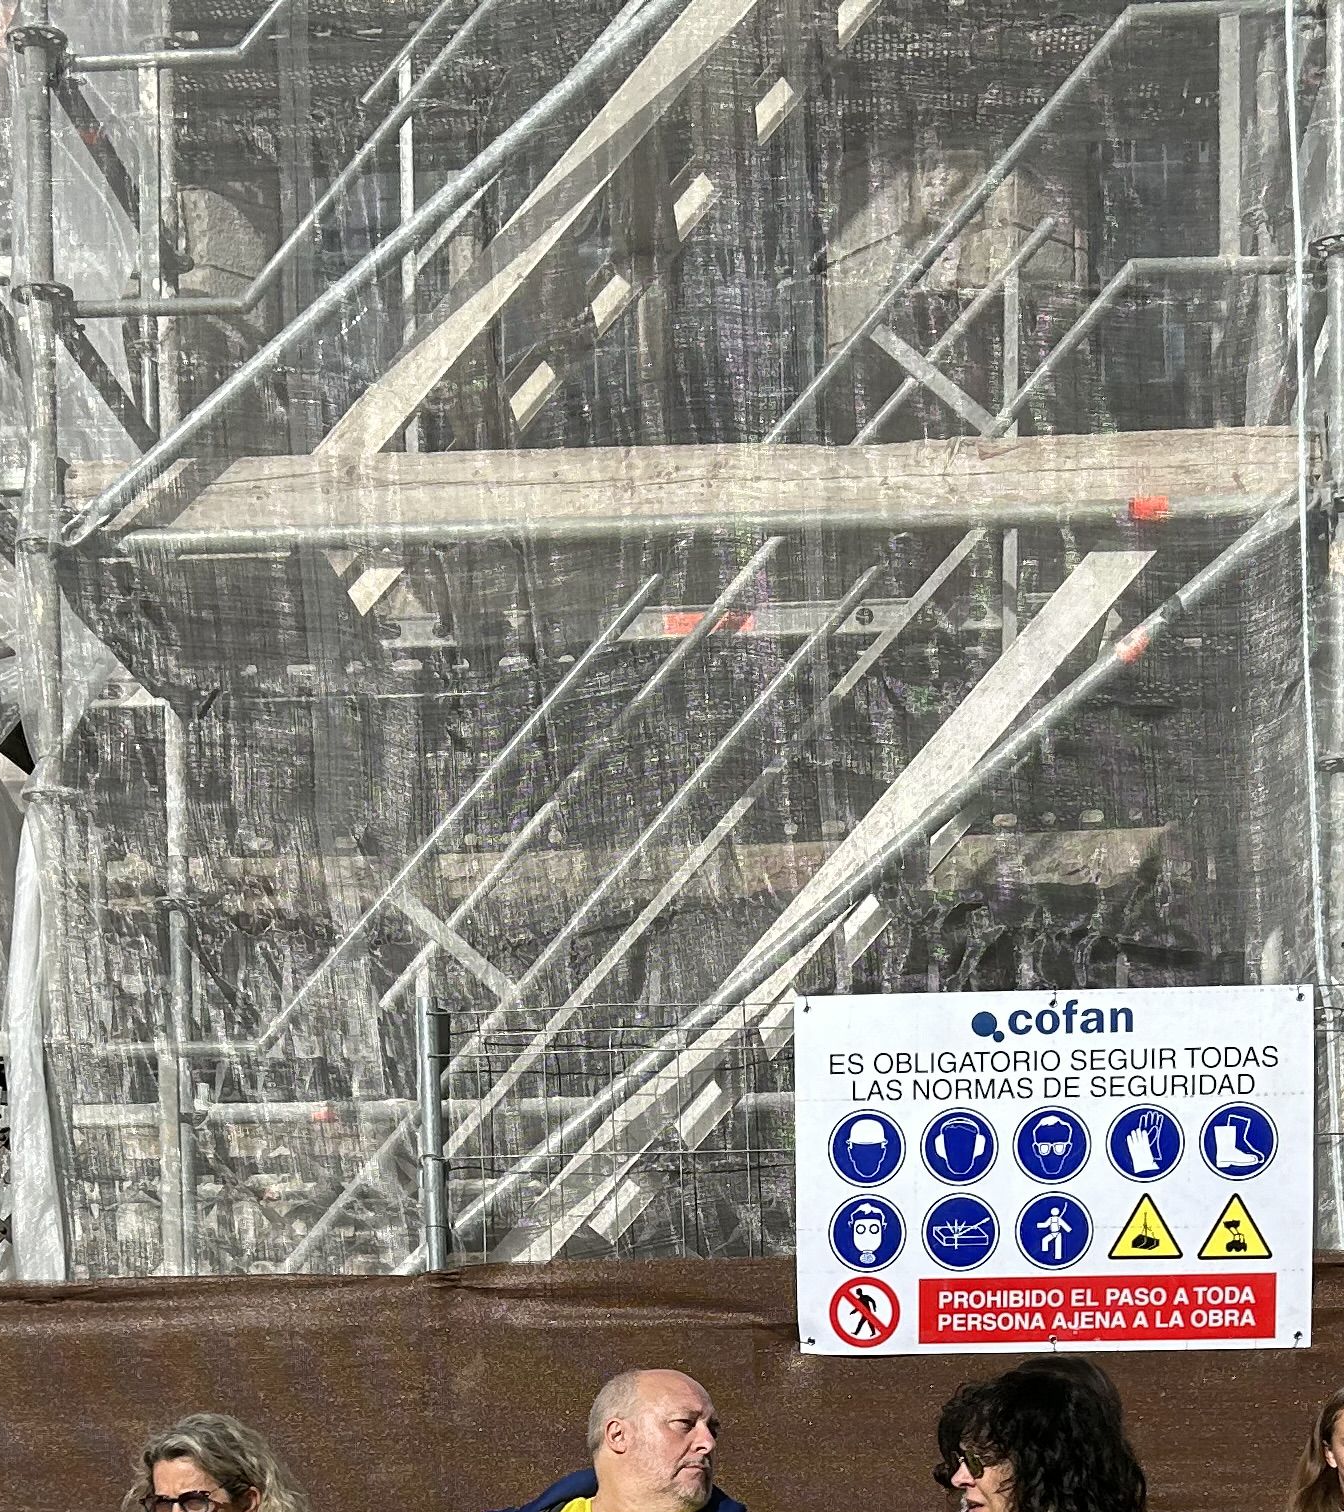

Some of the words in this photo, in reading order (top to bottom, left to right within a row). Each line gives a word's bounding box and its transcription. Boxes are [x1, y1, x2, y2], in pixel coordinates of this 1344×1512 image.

[1008, 999, 1134, 1035] cofan
[830, 1053, 864, 1075] ES
[874, 1050, 1060, 1074] OBLIGATORIO
[1071, 1048, 1176, 1071] SEGUIR
[1184, 1046, 1278, 1068] TODAS
[853, 1079, 902, 1101] LAS
[913, 1077, 1033, 1100] NORMAS
[1044, 1077, 1080, 1098] DE
[1090, 1074, 1255, 1097] SEGURIDAD
[939, 1289, 1064, 1308] PROHIBIDO
[1071, 1289, 1099, 1306] EL
[1106, 1288, 1166, 1305] PASO
[1174, 1288, 1189, 1305] A
[1193, 1286, 1255, 1304] TODA
[938, 1313, 1045, 1331] PERSONA
[1053, 1311, 1125, 1330] AJENA
[1133, 1311, 1148, 1327] A
[1156, 1311, 1184, 1327] LA
[1191, 1309, 1255, 1327] OBRA
